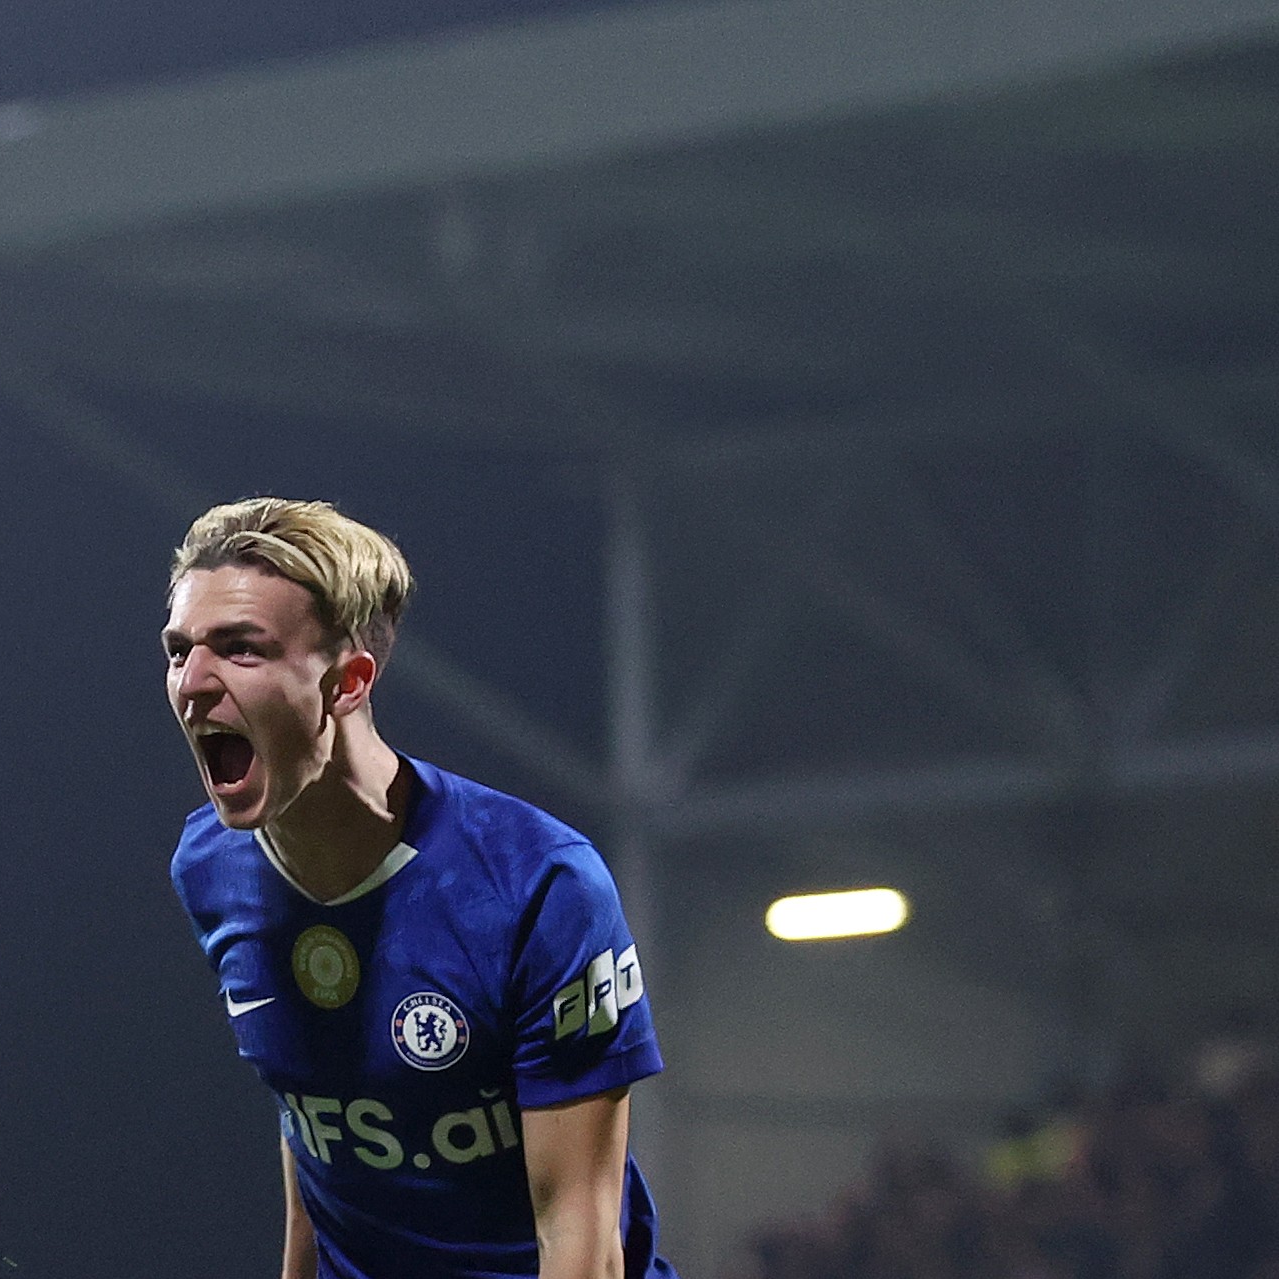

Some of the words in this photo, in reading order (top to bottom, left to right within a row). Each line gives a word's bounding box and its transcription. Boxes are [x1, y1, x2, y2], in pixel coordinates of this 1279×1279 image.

[403, 996, 451, 1013] CHELSEA
[557, 961, 636, 1026] FPT
[284, 1088, 519, 1170] IFS.ai
